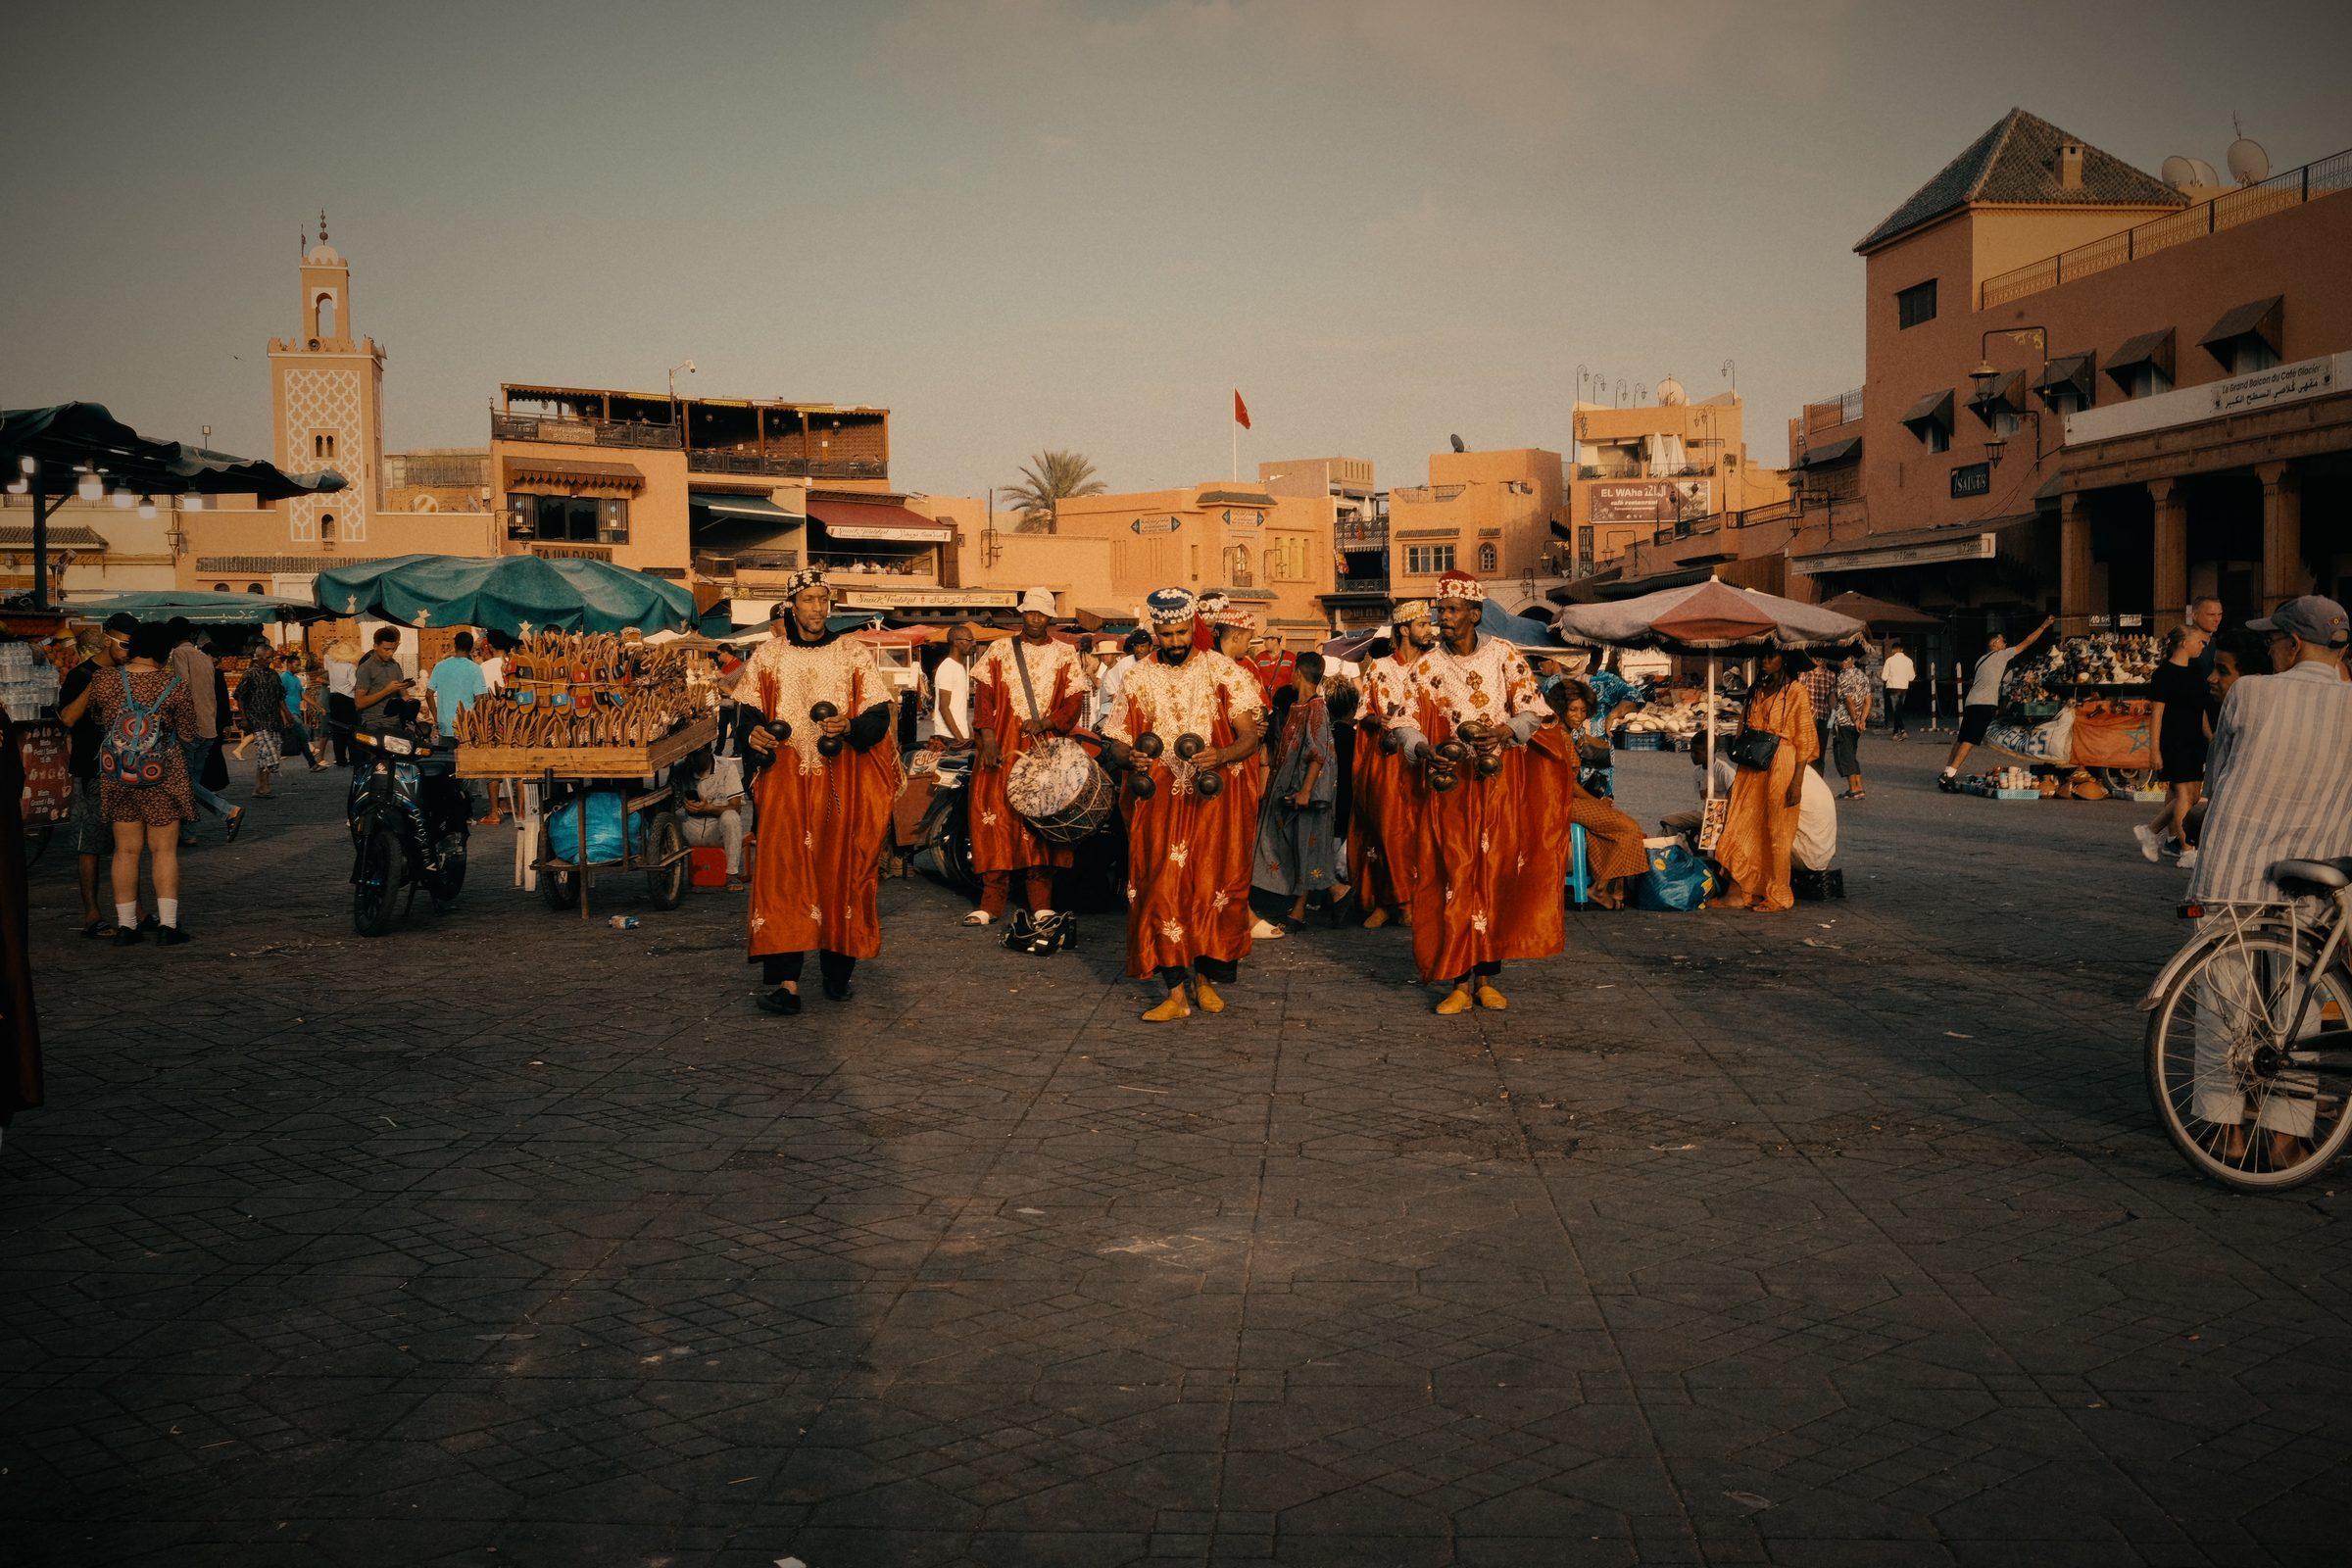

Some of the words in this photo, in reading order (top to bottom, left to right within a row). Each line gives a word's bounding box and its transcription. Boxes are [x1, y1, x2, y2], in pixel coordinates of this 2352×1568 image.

[2222, 384, 2230, 394] Le
[2230, 380, 2248, 391] Grand
[2249, 375, 2271, 387] Balcon
[2272, 372, 2280, 383] du
[2280, 369, 2296, 381] Café
[2298, 364, 2322, 377] Glacier
